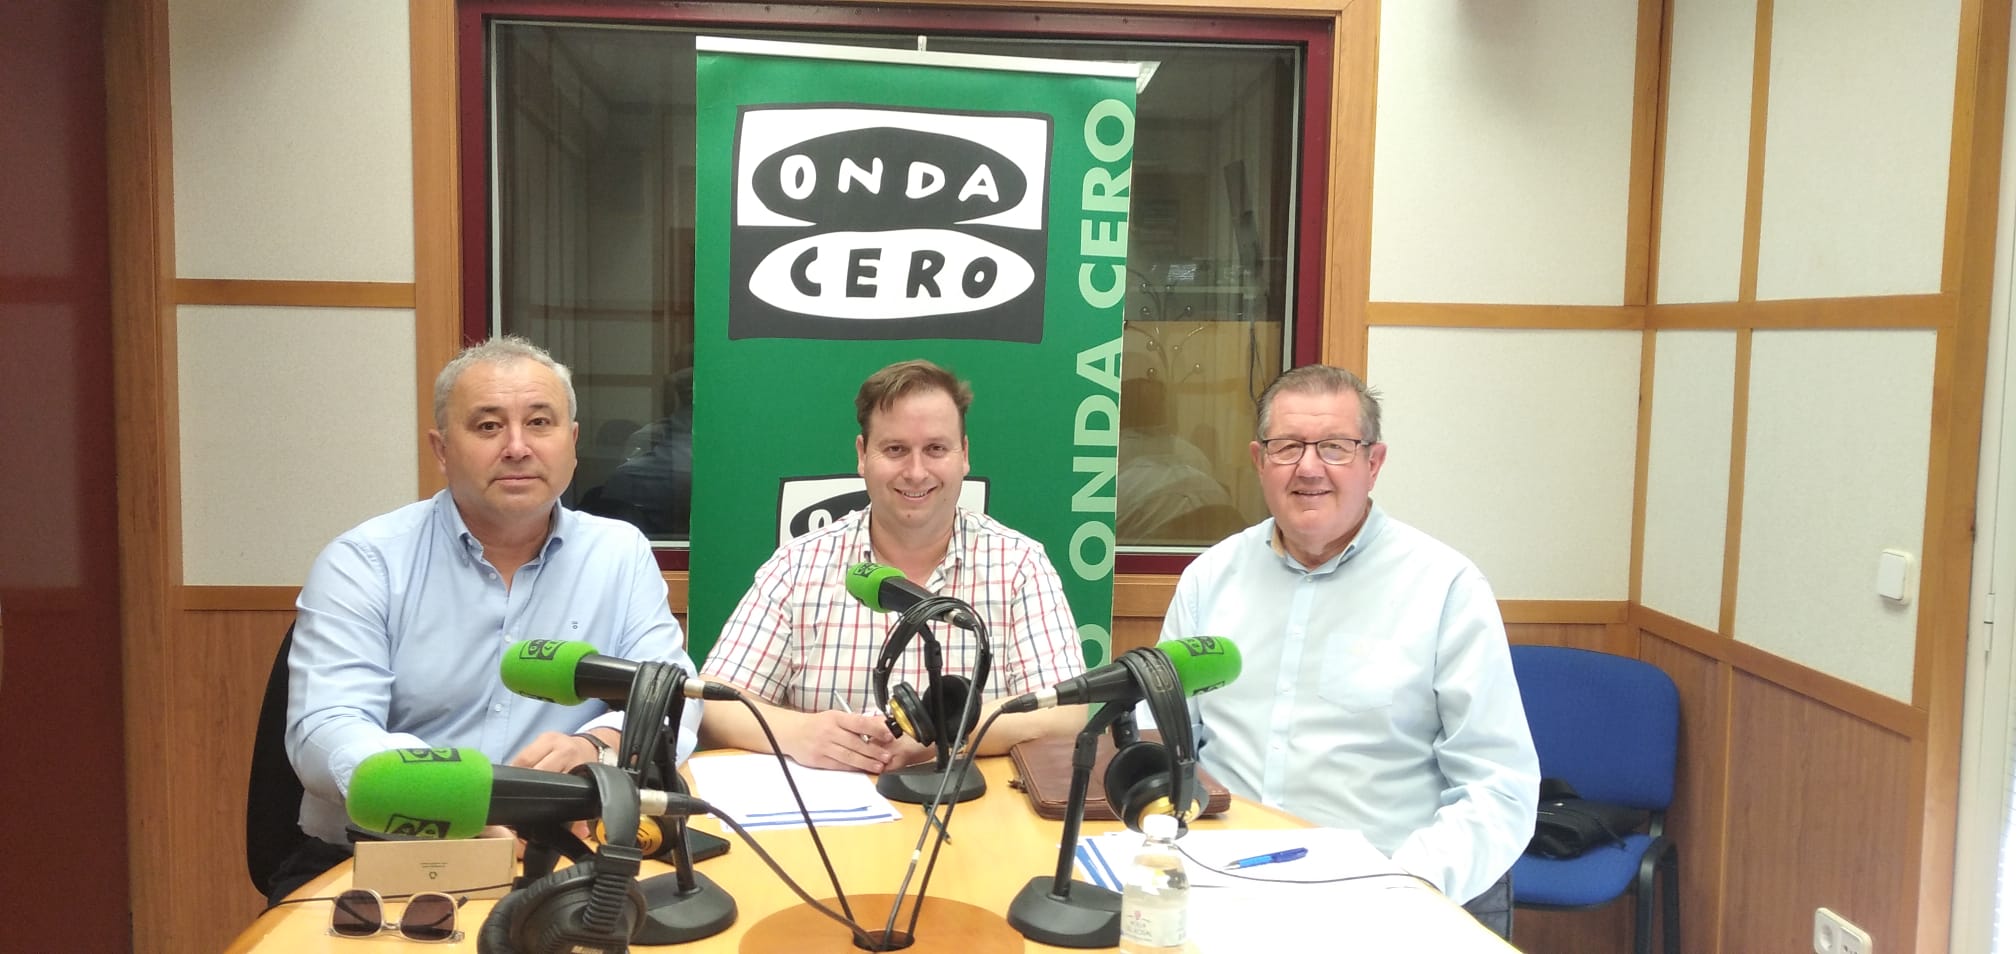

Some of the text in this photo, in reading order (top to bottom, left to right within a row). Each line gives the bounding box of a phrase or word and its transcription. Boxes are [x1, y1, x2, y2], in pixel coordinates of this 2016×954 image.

[780, 154, 999, 203] ONDA
[1078, 98, 1135, 309] CERO
[790, 246, 998, 299] CERO
[1069, 337, 1123, 580] ONDA
